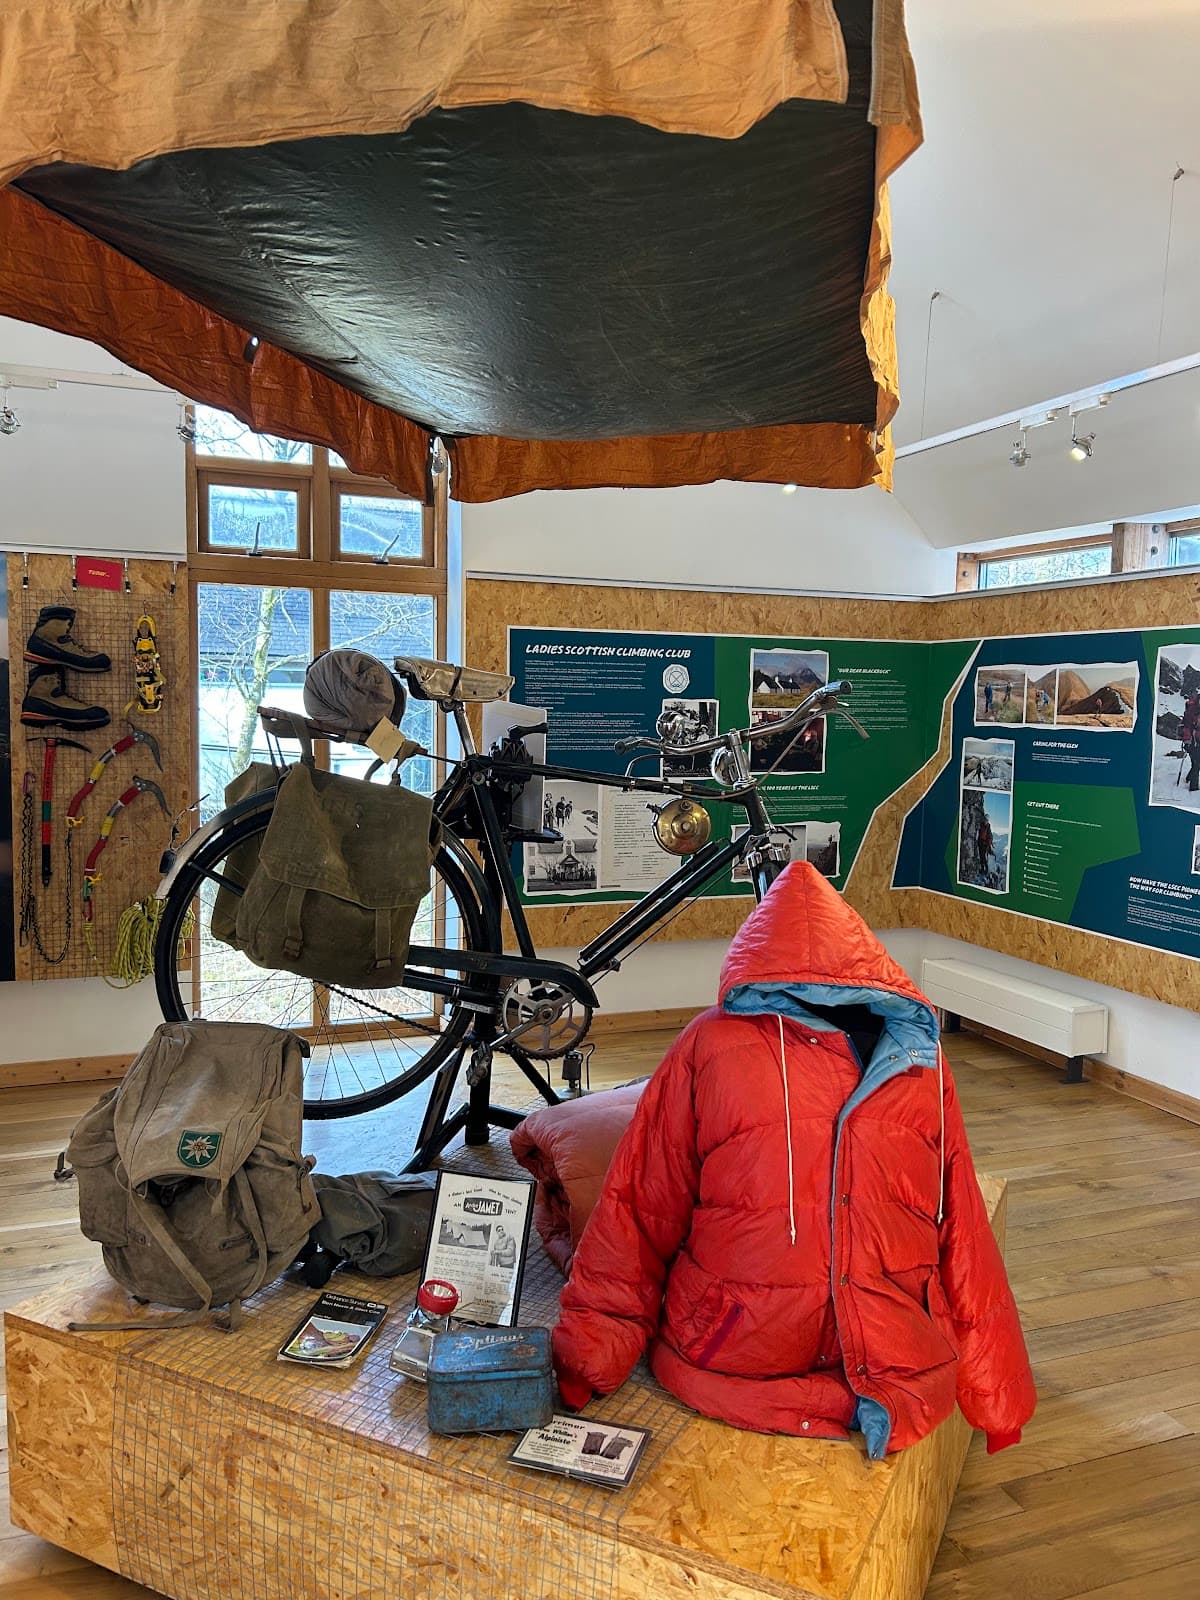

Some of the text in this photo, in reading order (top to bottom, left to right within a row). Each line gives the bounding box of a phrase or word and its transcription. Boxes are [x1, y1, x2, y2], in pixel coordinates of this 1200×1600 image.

[525, 644, 692, 659] LADIES SCOTTISH CLIMBING CLUB
[1142, 879, 1157, 887] HAVE
[1157, 881, 1168, 889] THE
[1140, 885, 1153, 893] WAY
[1152, 887, 1163, 895] FOR
[1163, 889, 1193, 901] CLIMBING?
[473, 1200, 501, 1215] JAMET
